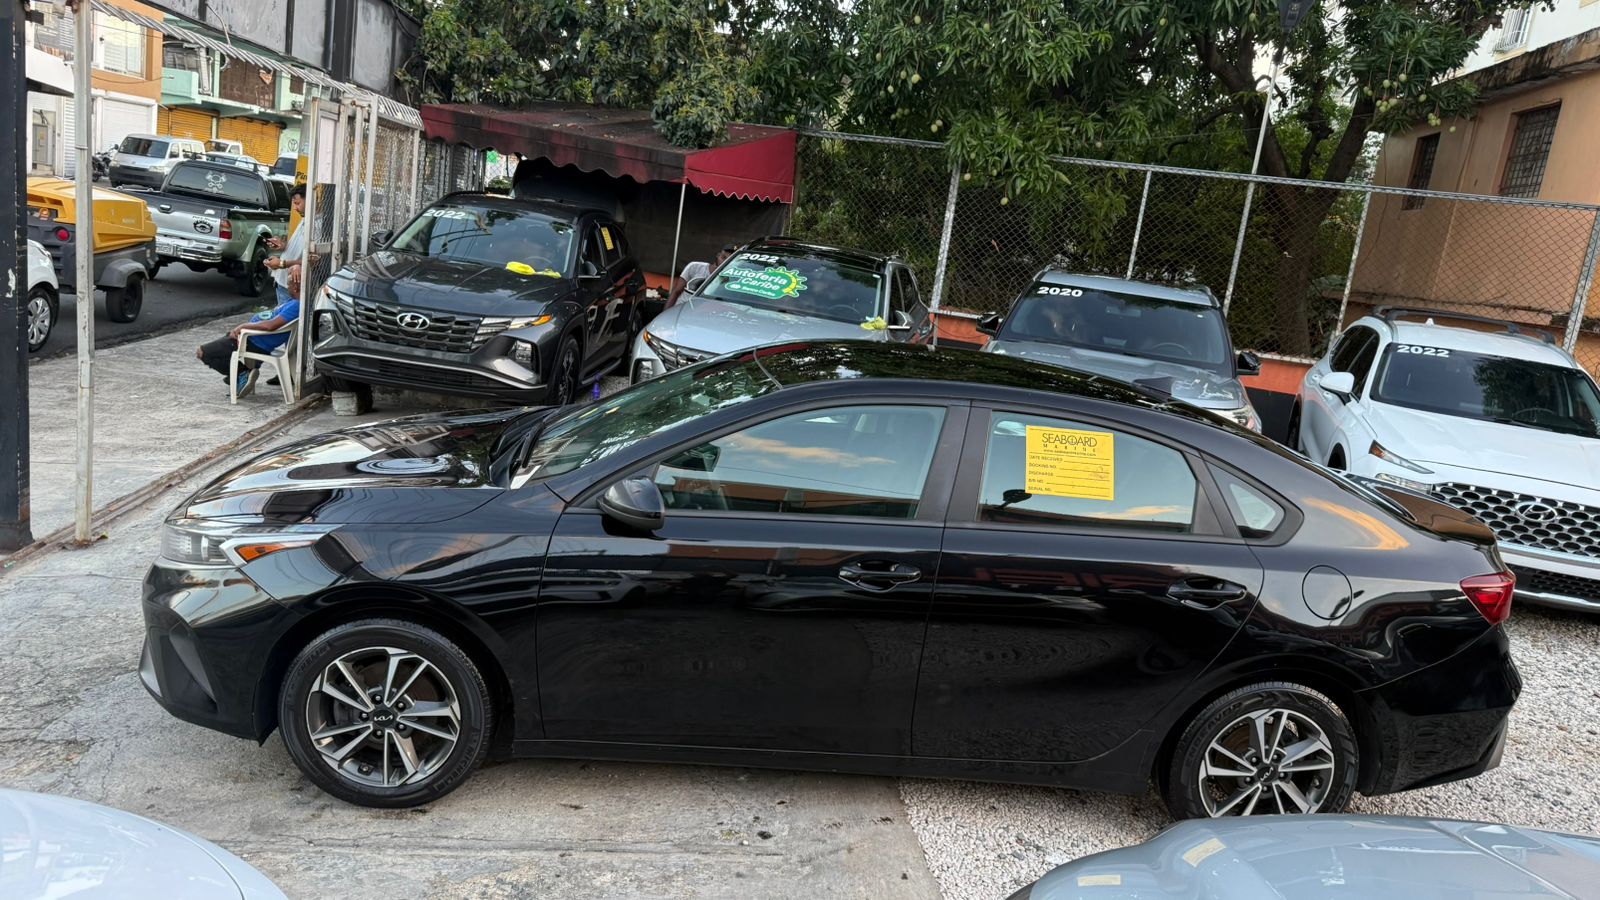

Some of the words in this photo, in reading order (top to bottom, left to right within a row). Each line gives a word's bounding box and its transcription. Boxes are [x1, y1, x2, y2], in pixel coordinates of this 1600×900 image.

[422, 209, 466, 219] 2022
[739, 253, 780, 263] 2022
[723, 268, 788, 285] Autoferia
[741, 278, 780, 291] Caribe
[1036, 286, 1083, 298] 2020
[1396, 344, 1450, 358] 2022
[1042, 432, 1098, 447] SEABOARD
